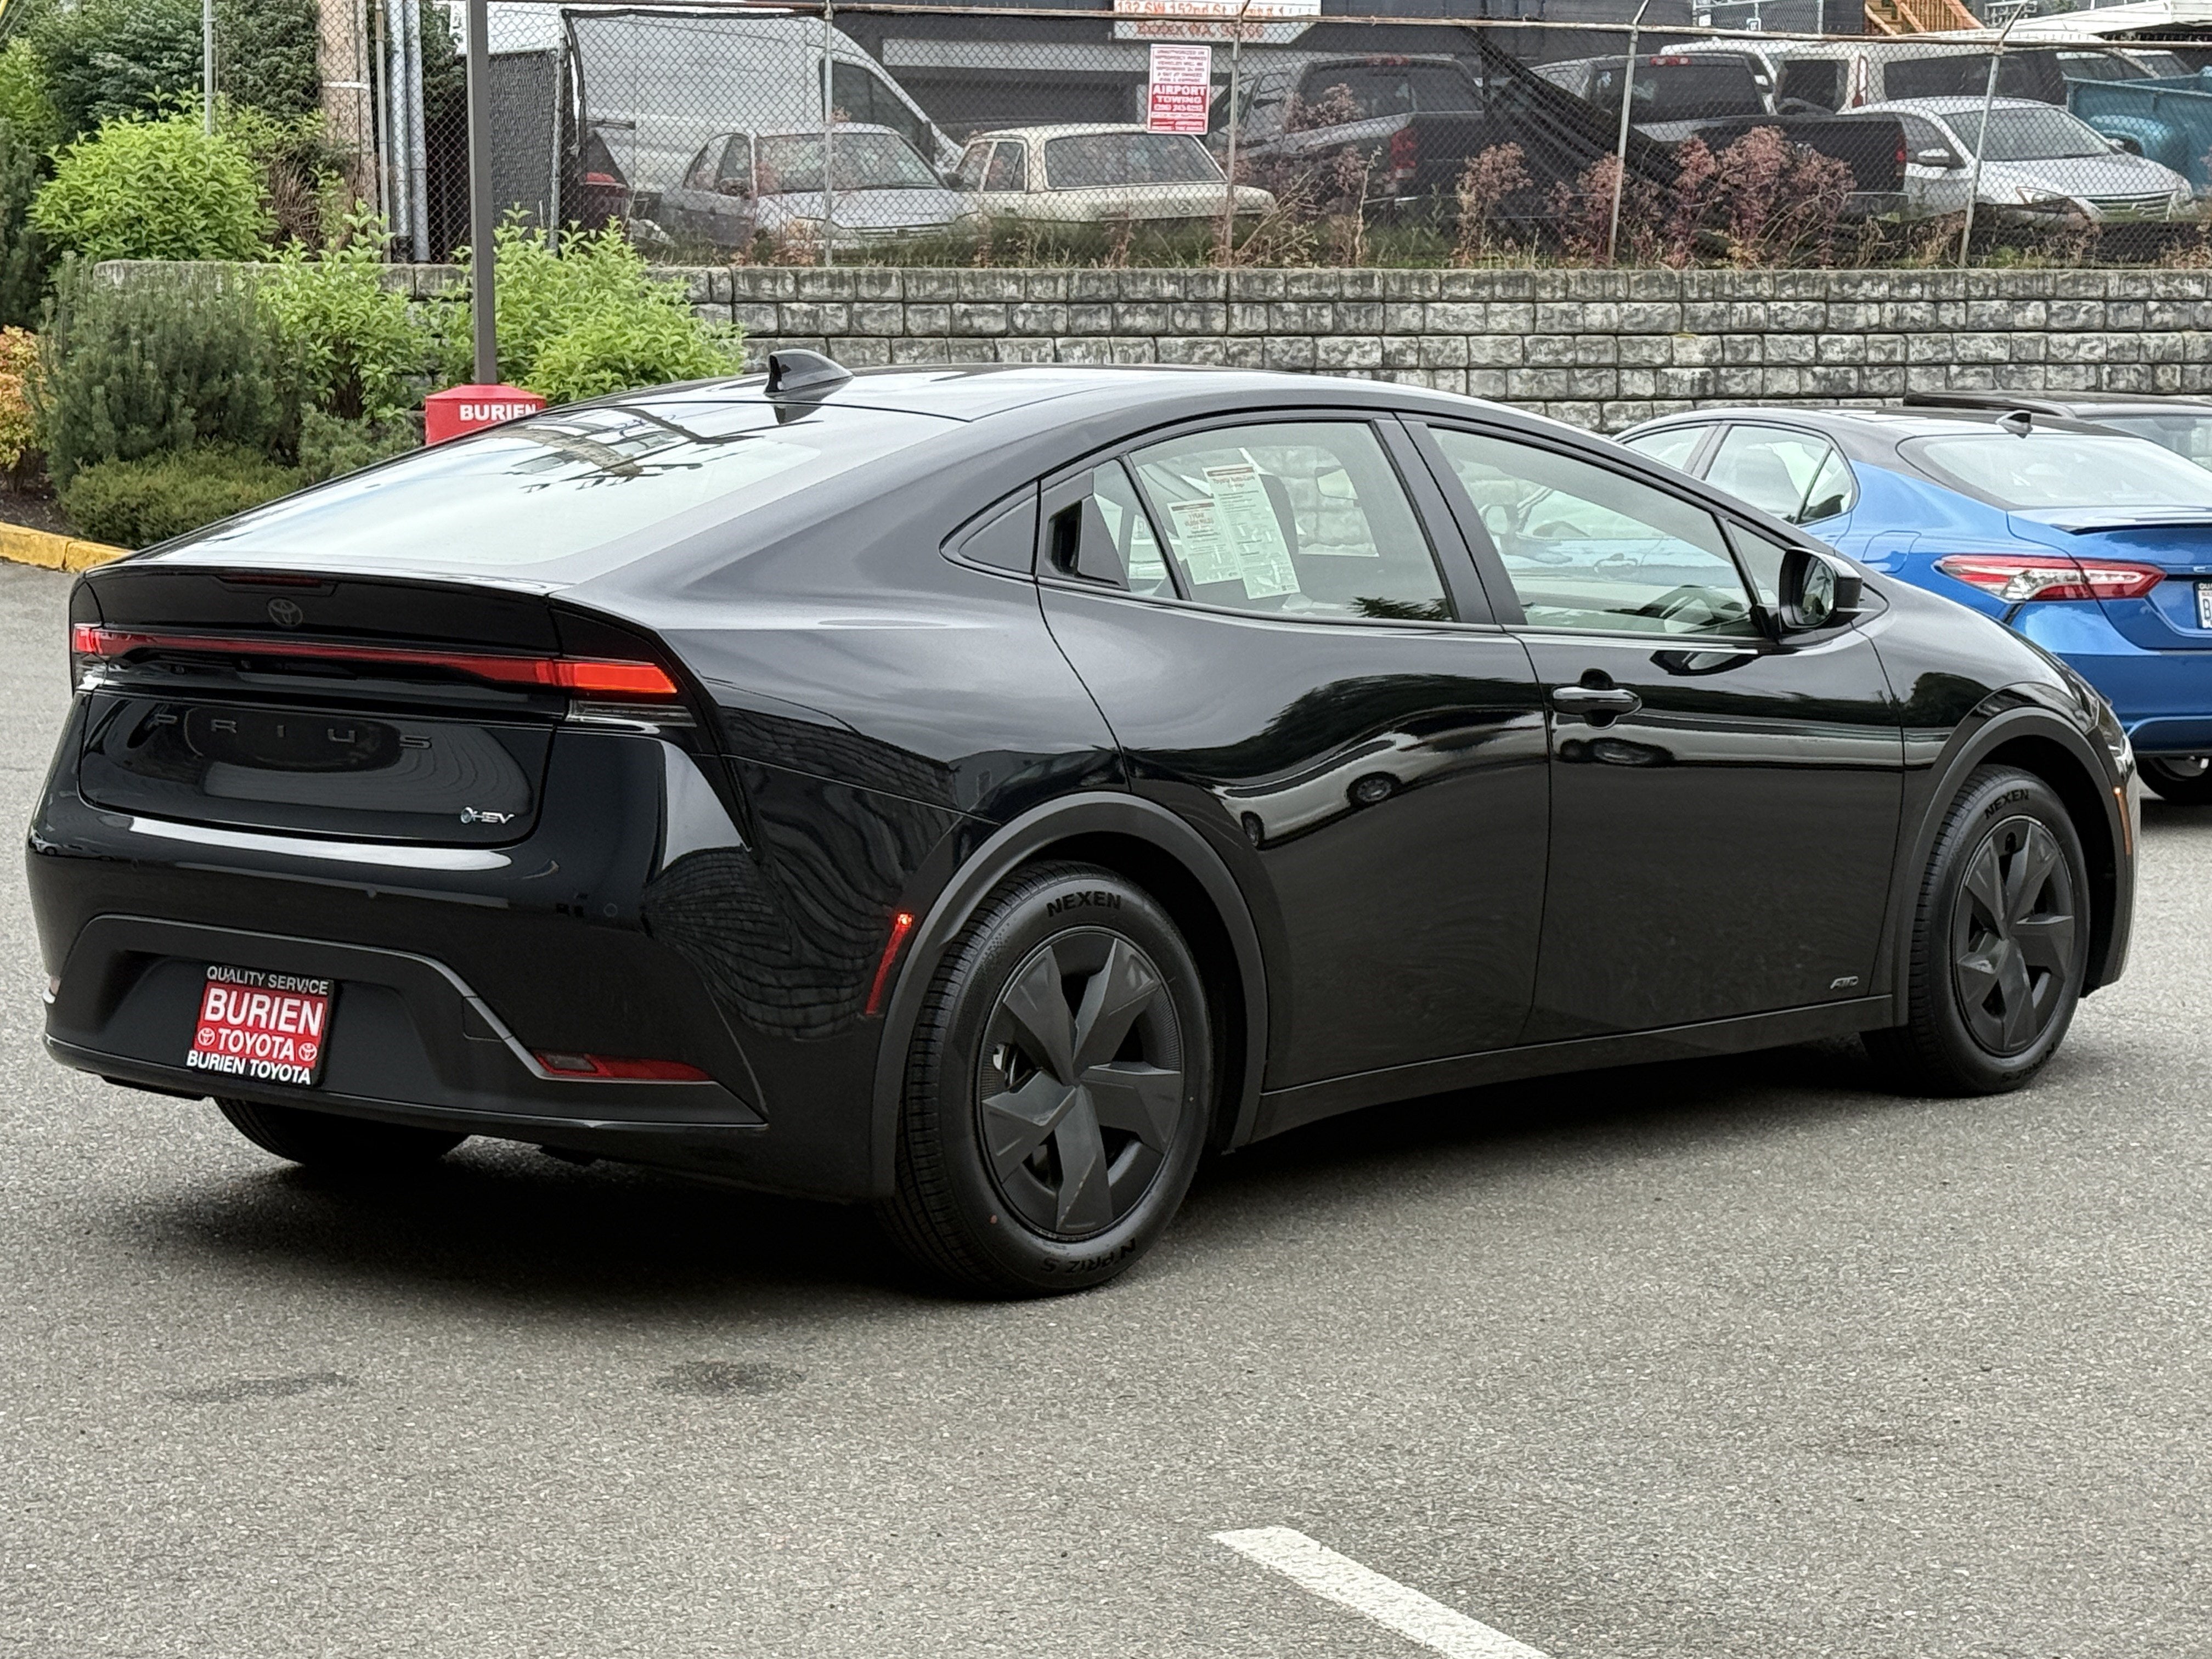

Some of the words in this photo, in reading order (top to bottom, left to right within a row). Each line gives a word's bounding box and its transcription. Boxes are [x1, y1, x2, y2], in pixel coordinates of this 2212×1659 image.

[1153, 84, 1206, 96] AIRPORT
[1156, 95, 1203, 104] TOWING
[460, 403, 537, 421] BURIEN
[148, 713, 432, 749] PRIUS
[472, 811, 515, 824] HEV
[1984, 788, 2030, 820] NEXEN
[1046, 890, 1122, 918] NEXEN
[206, 966, 266, 986] QUALITY
[268, 974, 329, 995] SERVICE
[204, 987, 324, 1036] BURIEN
[217, 1028, 295, 1062] TOYOTA
[186, 1050, 246, 1074] BURIEN
[250, 1058, 311, 1085] TOYOTA
